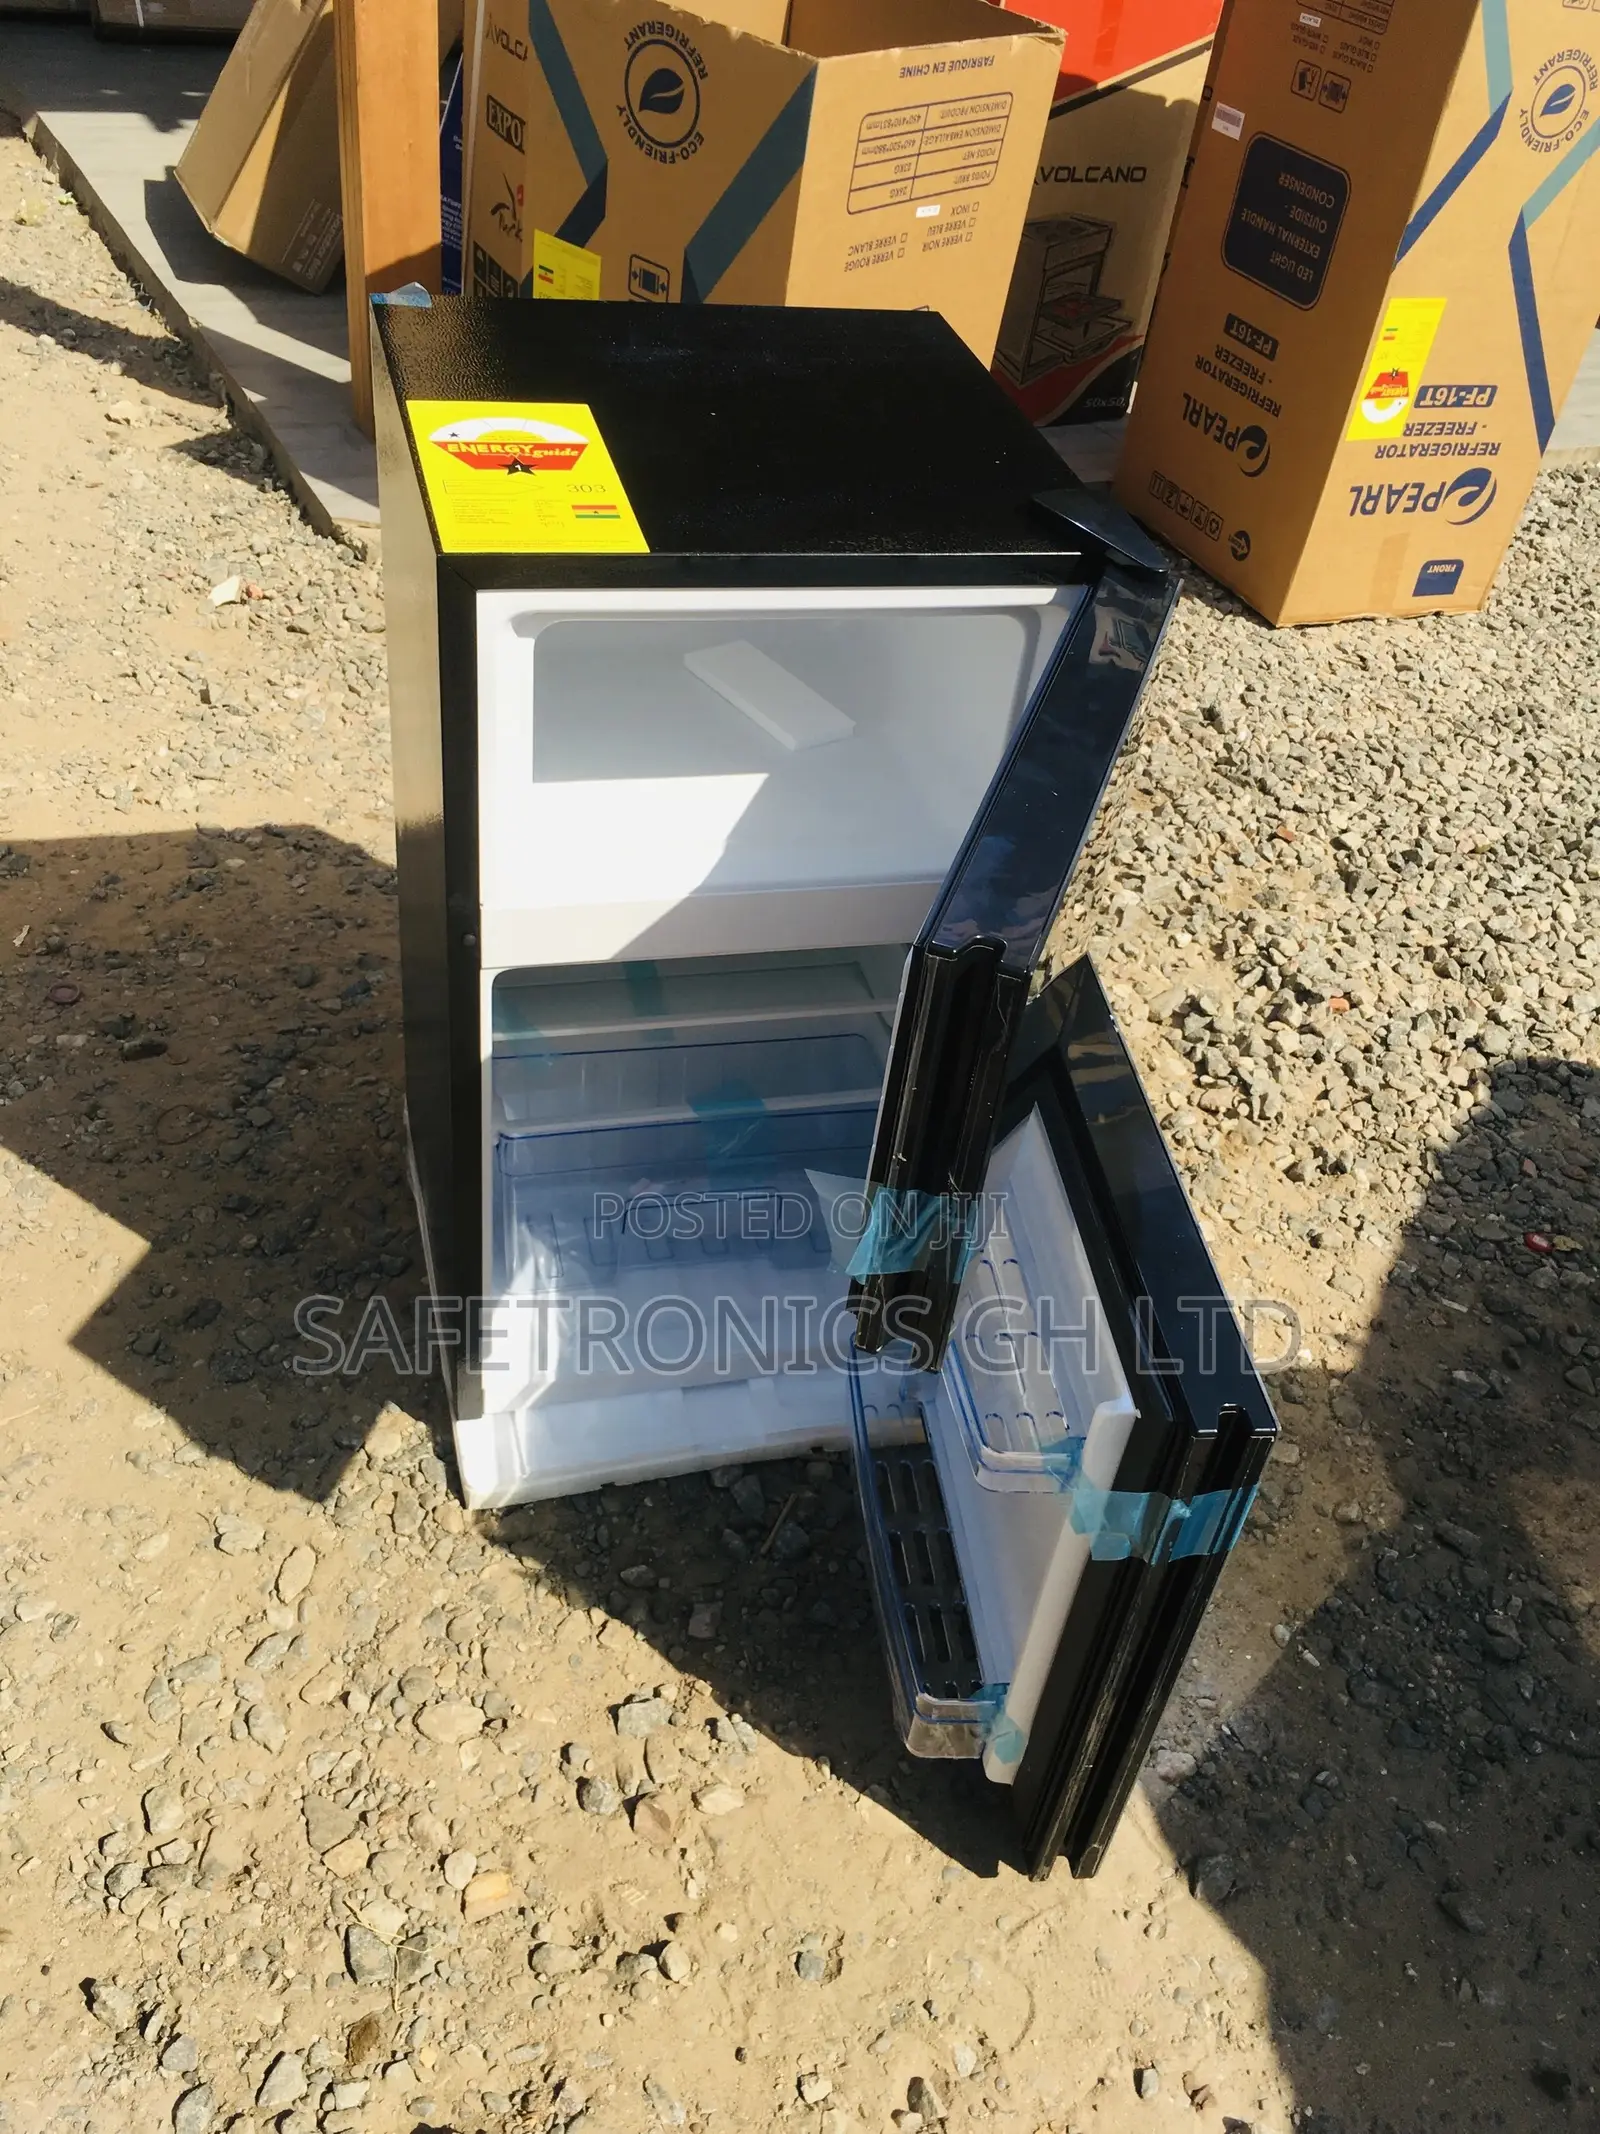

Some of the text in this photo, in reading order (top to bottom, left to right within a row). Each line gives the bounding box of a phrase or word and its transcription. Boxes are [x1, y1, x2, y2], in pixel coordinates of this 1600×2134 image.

[624, 21, 708, 80] REFRIGERANT
[899, 63, 930, 78] CHINE
[932, 61, 945, 73] EN
[1533, 49, 1598, 91] REFRIGERANT
[968, 100, 1007, 114] DIMENSION
[489, 101, 521, 147] EXPO
[616, 105, 704, 164] ECO-FRIENDLY
[964, 123, 1002, 137] DIMENSION
[1519, 108, 1589, 153] ECO-FRIENDLY
[1040, 166, 1147, 183] VOLCANO
[1278, 172, 1335, 208] CONDENSER
[950, 205, 970, 216] INOX
[1289, 205, 1327, 233] OUTSIDE
[927, 219, 966, 237] VERRE BLEU
[1241, 208, 1320, 259] EXTERNAL HANDLE
[848, 235, 897, 256] VERRE BLANC
[922, 233, 963, 252] VERRE NOIR
[844, 251, 894, 272] VERRE ROUGE
[1270, 250, 1314, 283] LED LIGHT
[1230, 320, 1272, 355] PF-16T
[1215, 344, 1266, 385] FREEZER
[1195, 354, 1282, 418] REFRIGERATOR
[1420, 387, 1491, 406] PF-16T
[1183, 392, 1240, 452] PEARL
[1403, 422, 1477, 436] FREEZER
[447, 442, 579, 458] ENERGY guide
[1375, 442, 1501, 458] REFRIGERATOR
[567, 484, 606, 493] 303
[1349, 481, 1447, 516] PEARL
[1427, 564, 1456, 573] FRONT
